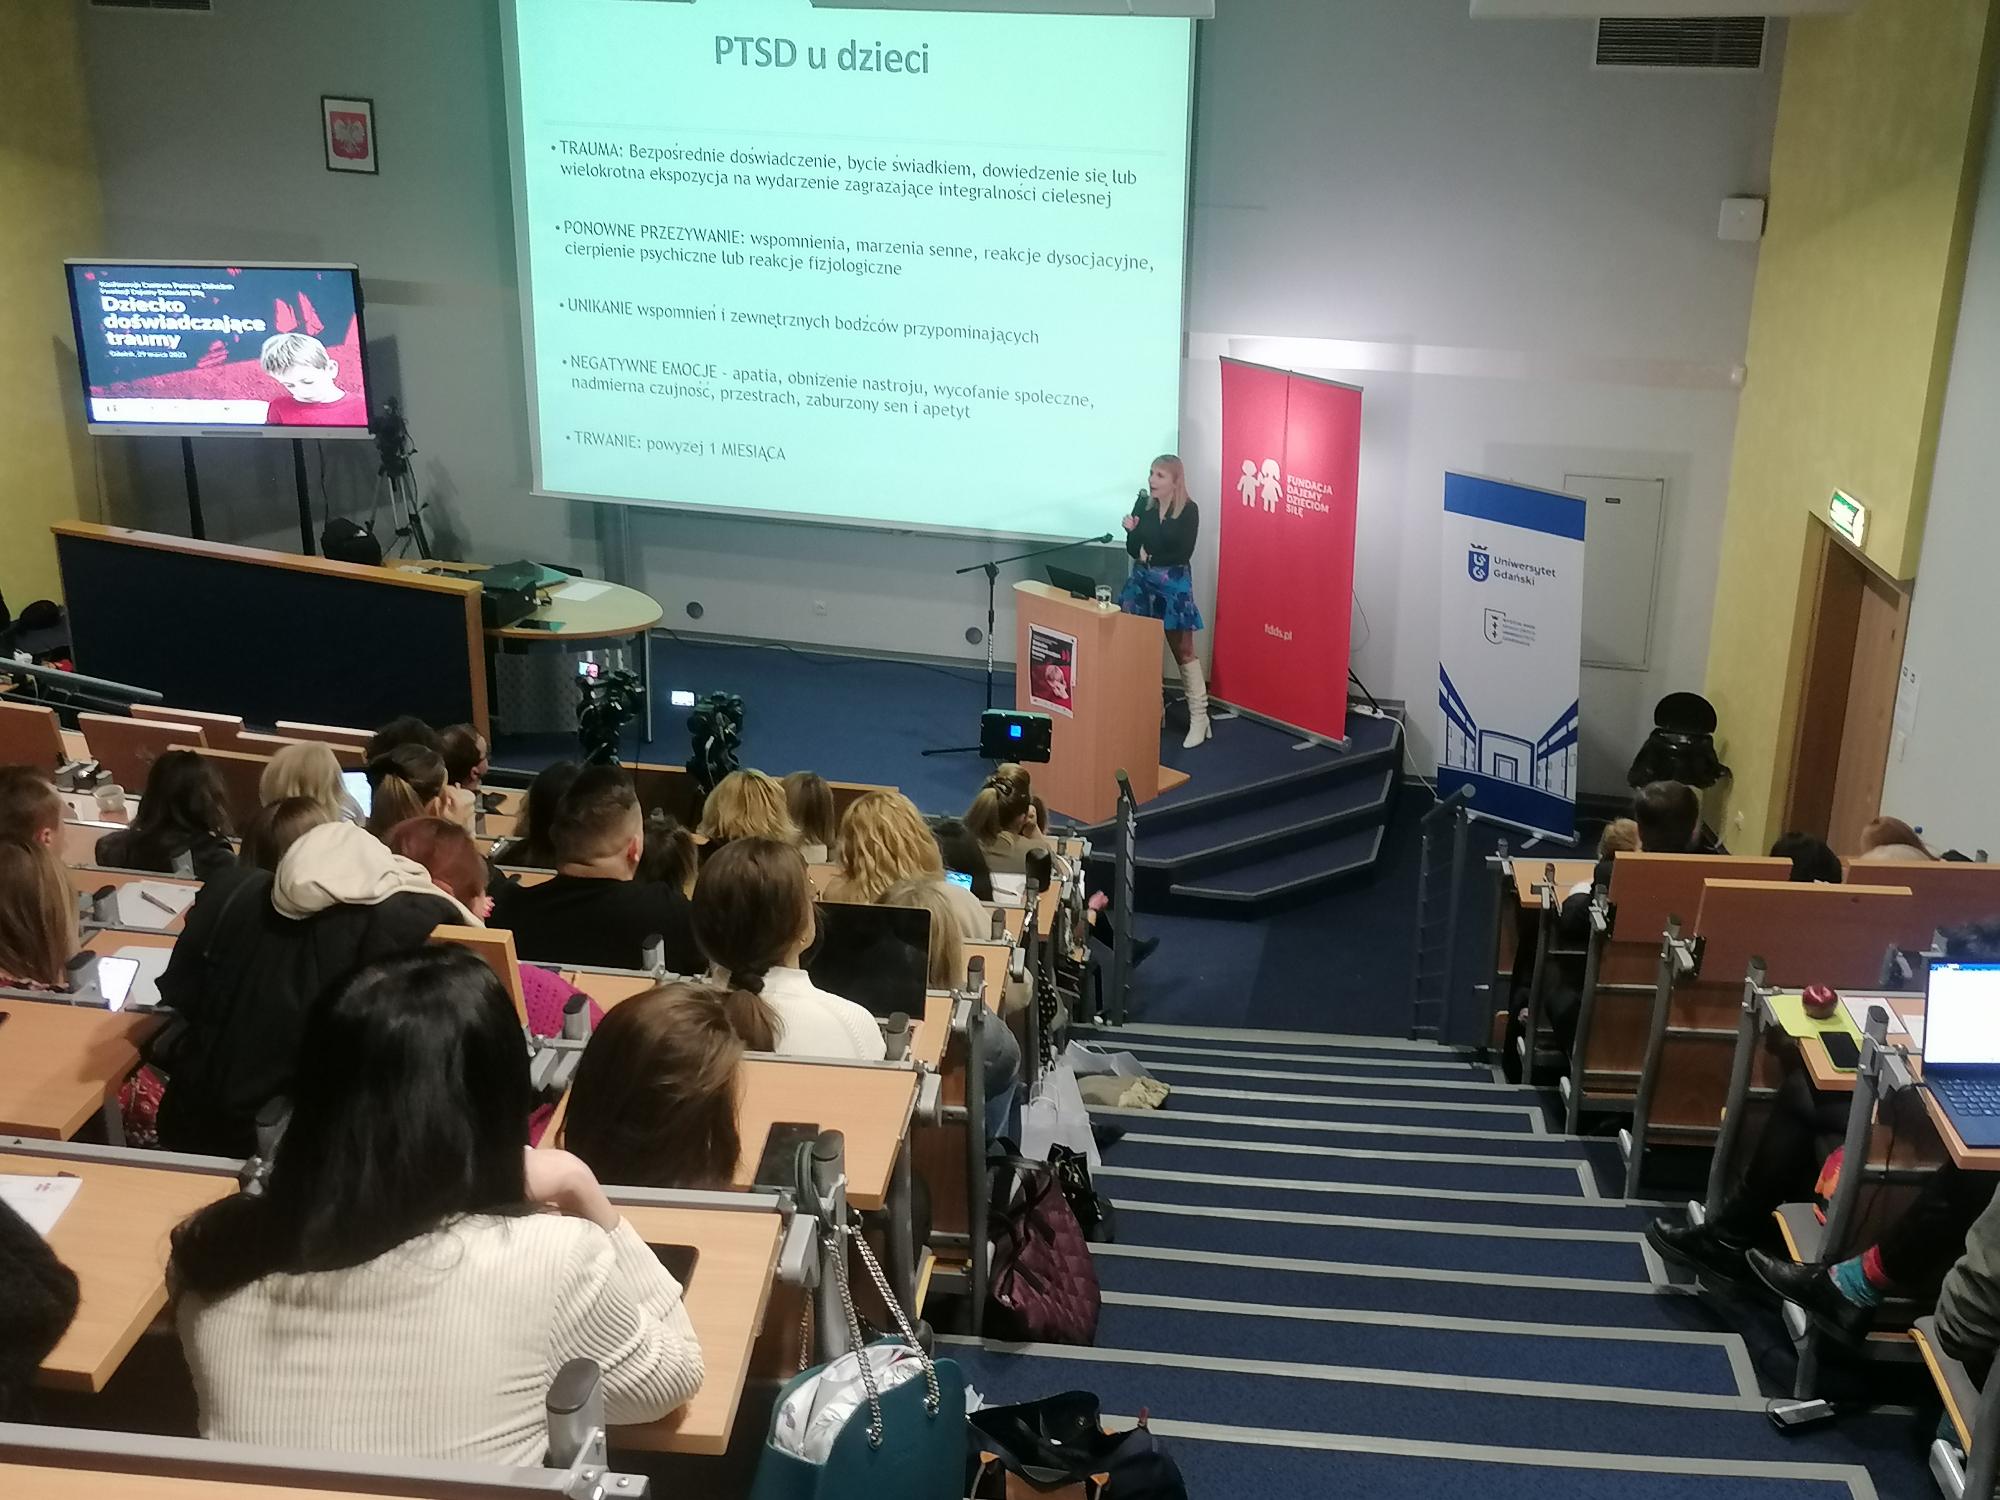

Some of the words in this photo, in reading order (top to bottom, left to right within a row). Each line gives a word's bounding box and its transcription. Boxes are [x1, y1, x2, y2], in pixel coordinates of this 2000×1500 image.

[715, 35, 797, 68] PTSD
[808, 46, 826, 70] u
[837, 39, 929, 74] dzieci
[560, 140, 624, 158] TRAUMA:
[629, 142, 725, 163] Bezpośrednie
[730, 146, 842, 171] doświadczenie,
[848, 155, 887, 174] bycie
[892, 154, 976, 179] świadkiem,
[982, 163, 1080, 184] dowiedzenie
[1085, 168, 1109, 187] się
[1112, 169, 1137, 186] lub
[560, 163, 645, 181] wielokrotna
[649, 167, 729, 186] ekspozycja
[734, 172, 751, 186] na
[756, 173, 840, 191] wydarzenie
[939, 182, 1036, 203] integralności
[1042, 188, 1112, 209] cielesnej
[564, 220, 636, 238] PONOWNE
[750, 233, 851, 253] wspomnienia,
[856, 239, 924, 256] marzenia
[929, 244, 978, 261] senne,
[984, 247, 1041, 265] reakcje
[1046, 248, 1154, 273] dysocjacyjne,
[565, 242, 635, 262] cierpienie
[640, 246, 717, 266] psychiczne
[722, 251, 744, 266] lub
[750, 253, 804, 271] reakcje
[809, 255, 902, 276] fizjologiczne
[101, 295, 186, 313] Dziecko
[103, 312, 266, 333] doświadczające
[568, 298, 633, 316] UNIKANIE
[637, 303, 717, 322] wspomnień
[721, 308, 726, 321] i
[730, 310, 830, 330] zewnętrznych
[903, 321, 1040, 345] przypominających
[105, 330, 181, 350] traumy
[570, 354, 657, 374] NEGATYWNE
[662, 361, 718, 379] EMOCJE
[732, 367, 782, 385] apatia,
[863, 376, 928, 397] nastroju,
[934, 382, 1010, 401] wycofanie
[571, 376, 645, 394] nadmierna
[650, 380, 715, 400] czujność,
[720, 387, 801, 407] przestrach,
[806, 393, 879, 414] zaburzony
[884, 401, 909, 415] sen
[913, 400, 918, 415] i
[923, 402, 972, 421] apetyt
[574, 430, 642, 449] TRWANIE:
[710, 442, 716, 455] 1
[721, 443, 787, 463] MIESIĄCA
[1286, 474, 1333, 496] FUNDACJA
[1286, 484, 1322, 502] DAJEMY
[1286, 493, 1329, 514] DZIECIOM
[1493, 555, 1556, 578] Uniwersytet
[1493, 569, 1535, 587] Gdański
